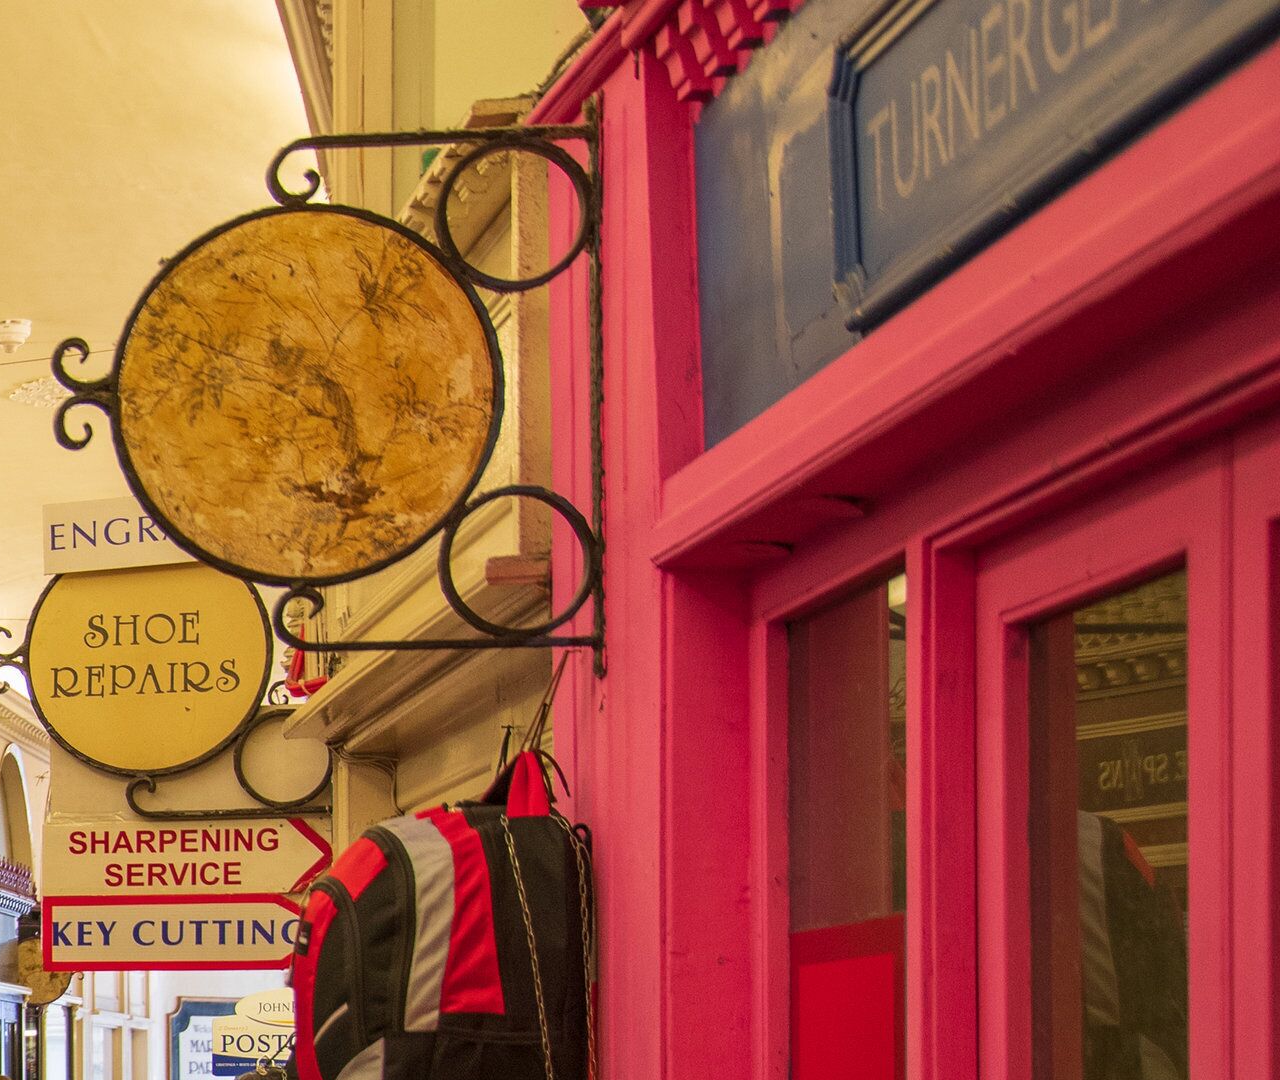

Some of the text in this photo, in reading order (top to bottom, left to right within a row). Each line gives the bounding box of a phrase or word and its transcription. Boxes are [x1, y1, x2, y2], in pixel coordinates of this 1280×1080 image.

[867, 0, 1039, 215] TURNER
[50, 516, 171, 552] ENGR
[83, 609, 201, 649] SHOE
[49, 658, 241, 699] REPAIRS
[68, 826, 280, 855] SHARPENING
[104, 861, 242, 887] SERVICE
[50, 919, 118, 947] KEY
